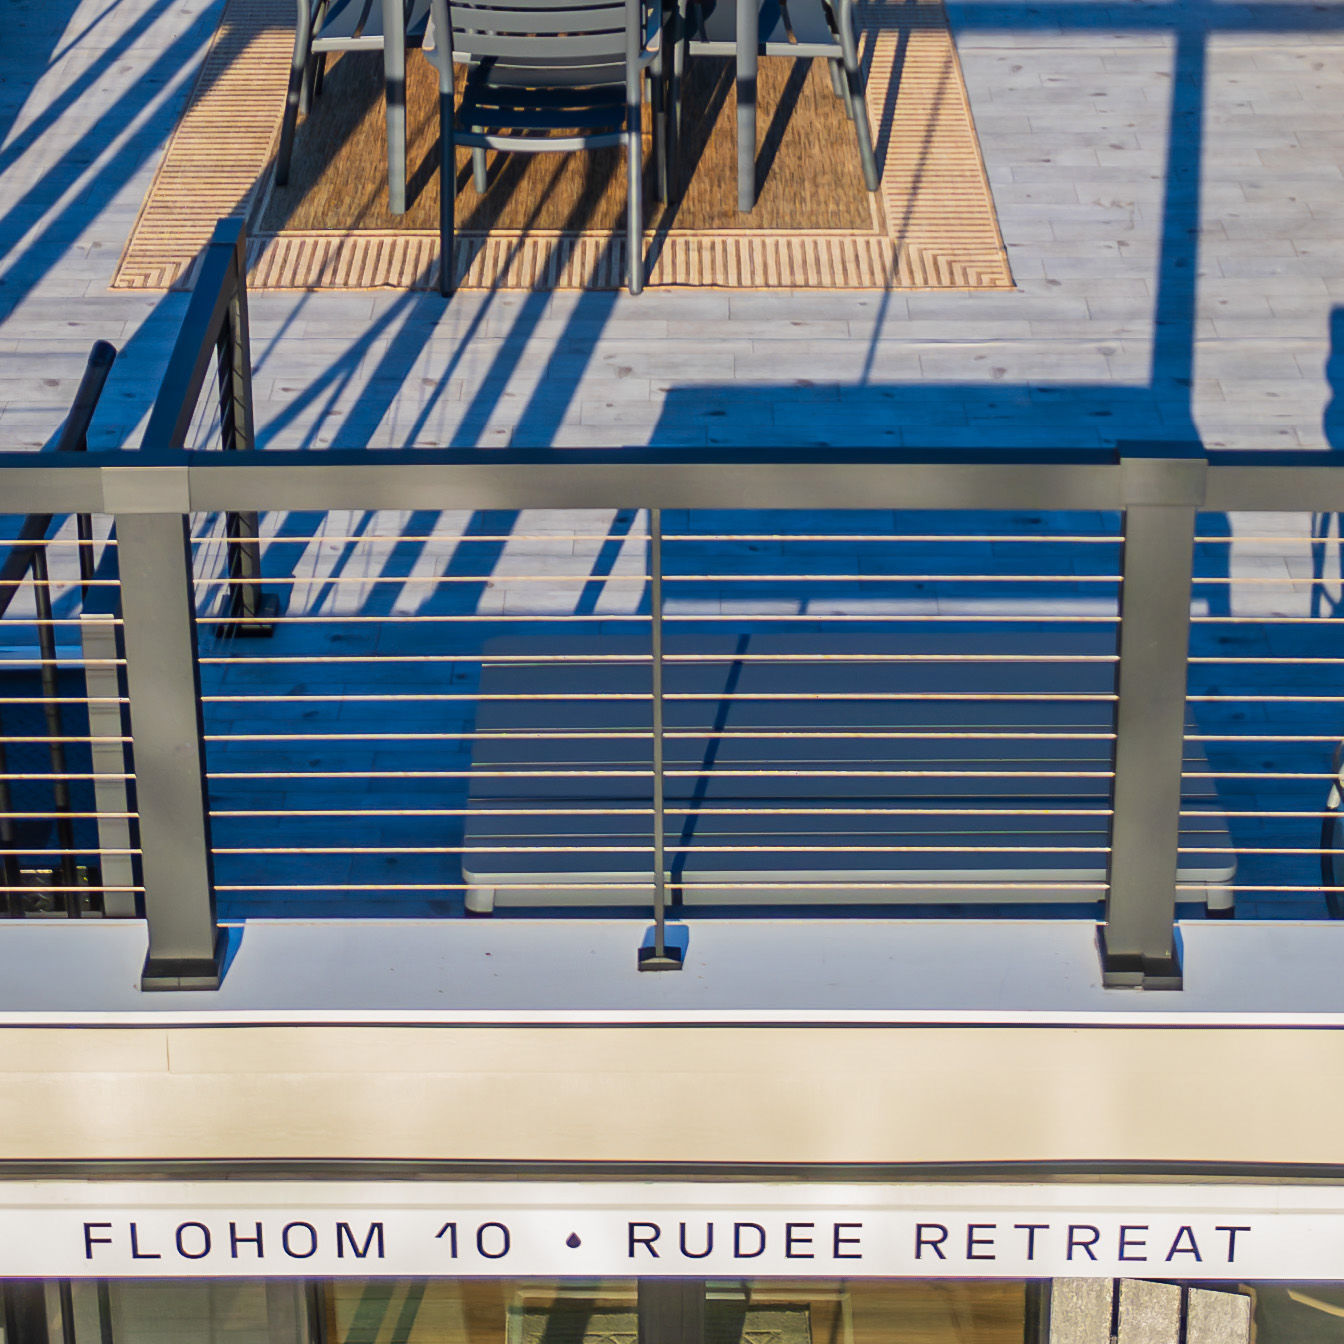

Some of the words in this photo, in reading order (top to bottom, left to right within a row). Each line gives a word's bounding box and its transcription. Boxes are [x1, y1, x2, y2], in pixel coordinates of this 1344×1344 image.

[83, 1221, 385, 1260] FLOHOM
[434, 1221, 511, 1260] 10
[627, 1221, 863, 1260] RUDEE
[914, 1222, 1252, 1263] RETREAT
